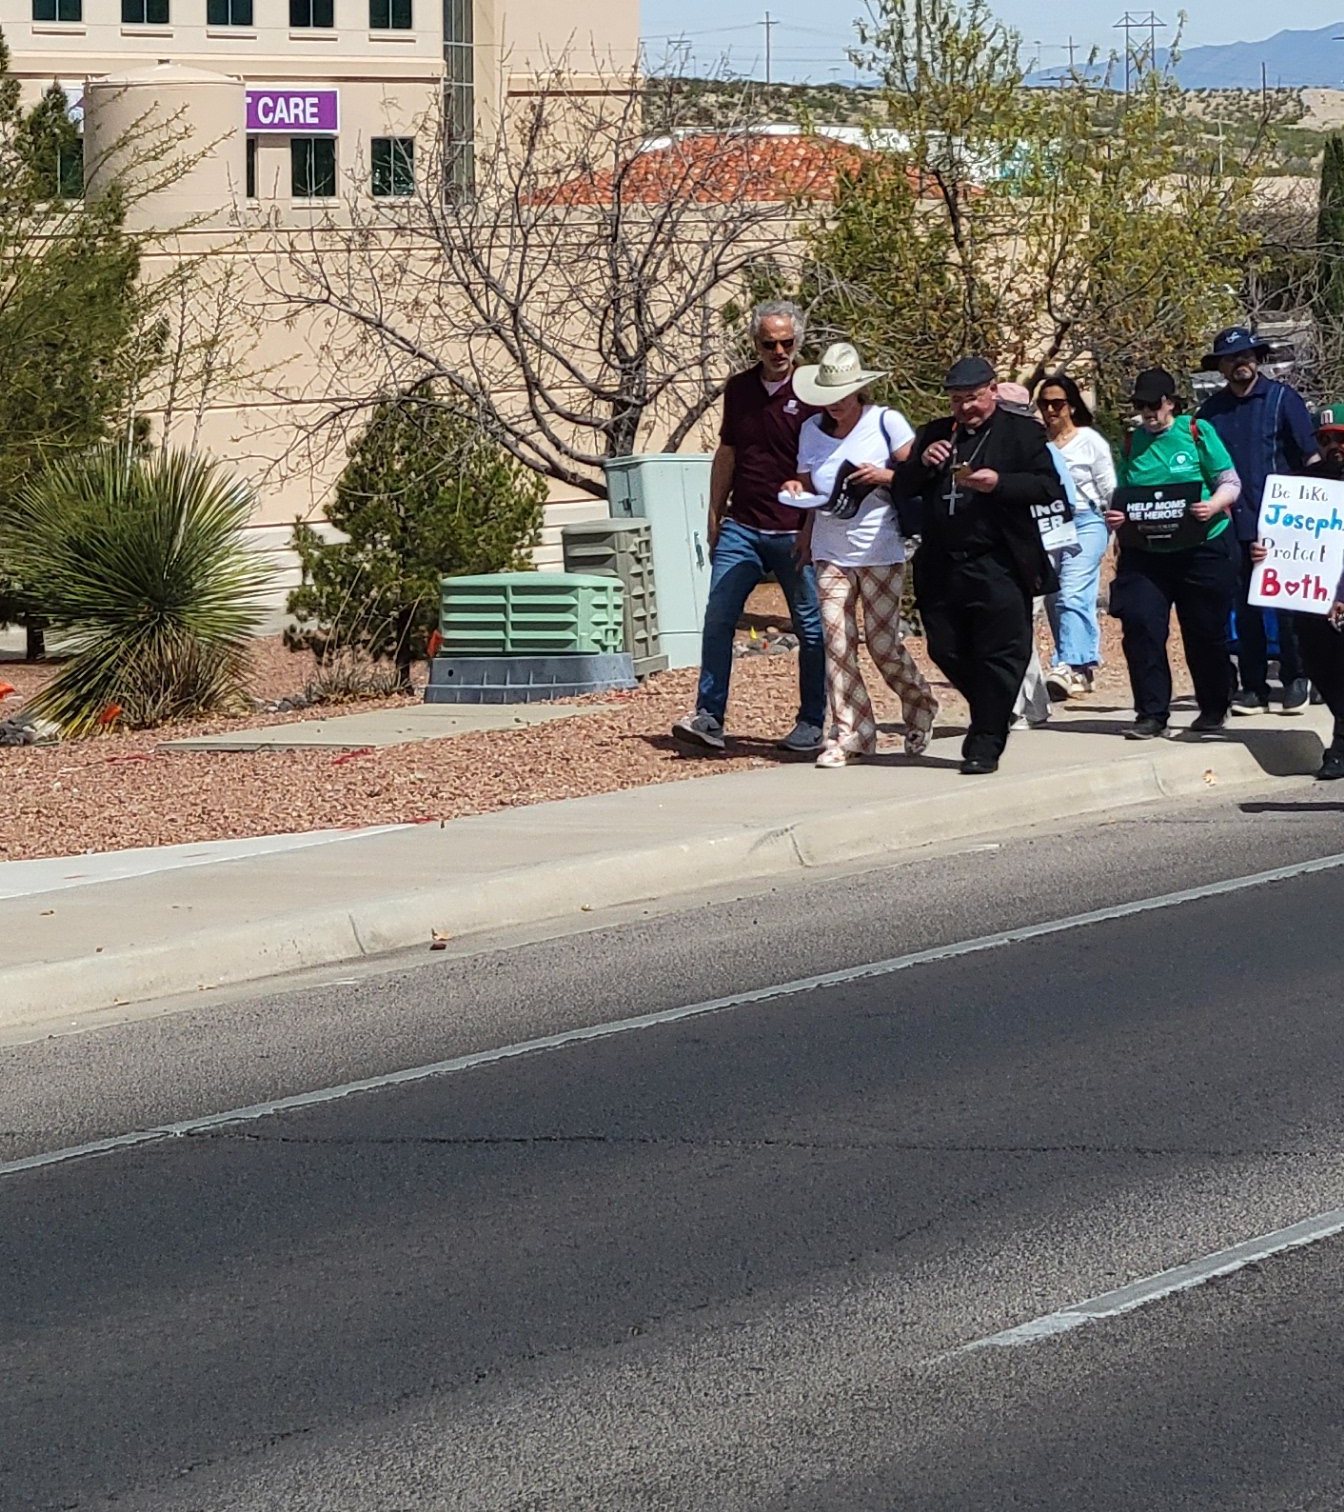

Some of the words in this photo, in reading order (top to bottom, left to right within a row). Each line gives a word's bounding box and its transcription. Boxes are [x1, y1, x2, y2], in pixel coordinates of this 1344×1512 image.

[257, 96, 319, 124] CARE
[1271, 483, 1290, 499] Be
[1030, 499, 1065, 518] ING
[1126, 502, 1153, 512] HELP
[1154, 499, 1186, 510] MOMS
[1129, 511, 1142, 521] BE
[1143, 508, 1184, 520] HEROES
[1037, 514, 1065, 533] ER
[1262, 537, 1325, 562] Protect
